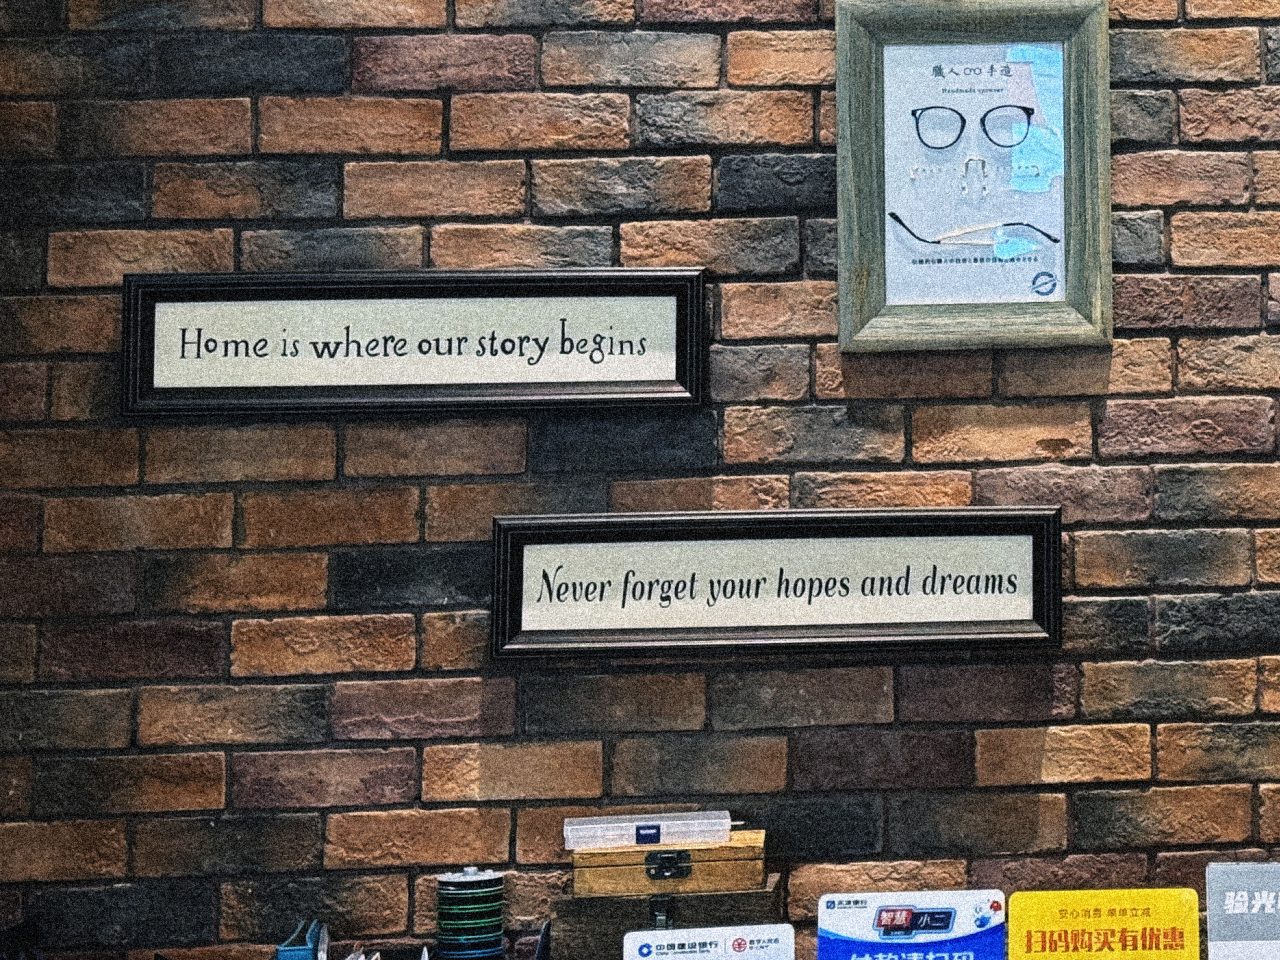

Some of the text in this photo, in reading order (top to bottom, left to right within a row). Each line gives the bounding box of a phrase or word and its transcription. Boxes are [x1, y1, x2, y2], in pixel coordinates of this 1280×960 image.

[179, 318, 648, 365] Home is where our story begins
[536, 563, 1019, 608] Never forget your hopes and dreams
[1024, 926, 1185, 954] 扫码购买有优惠
